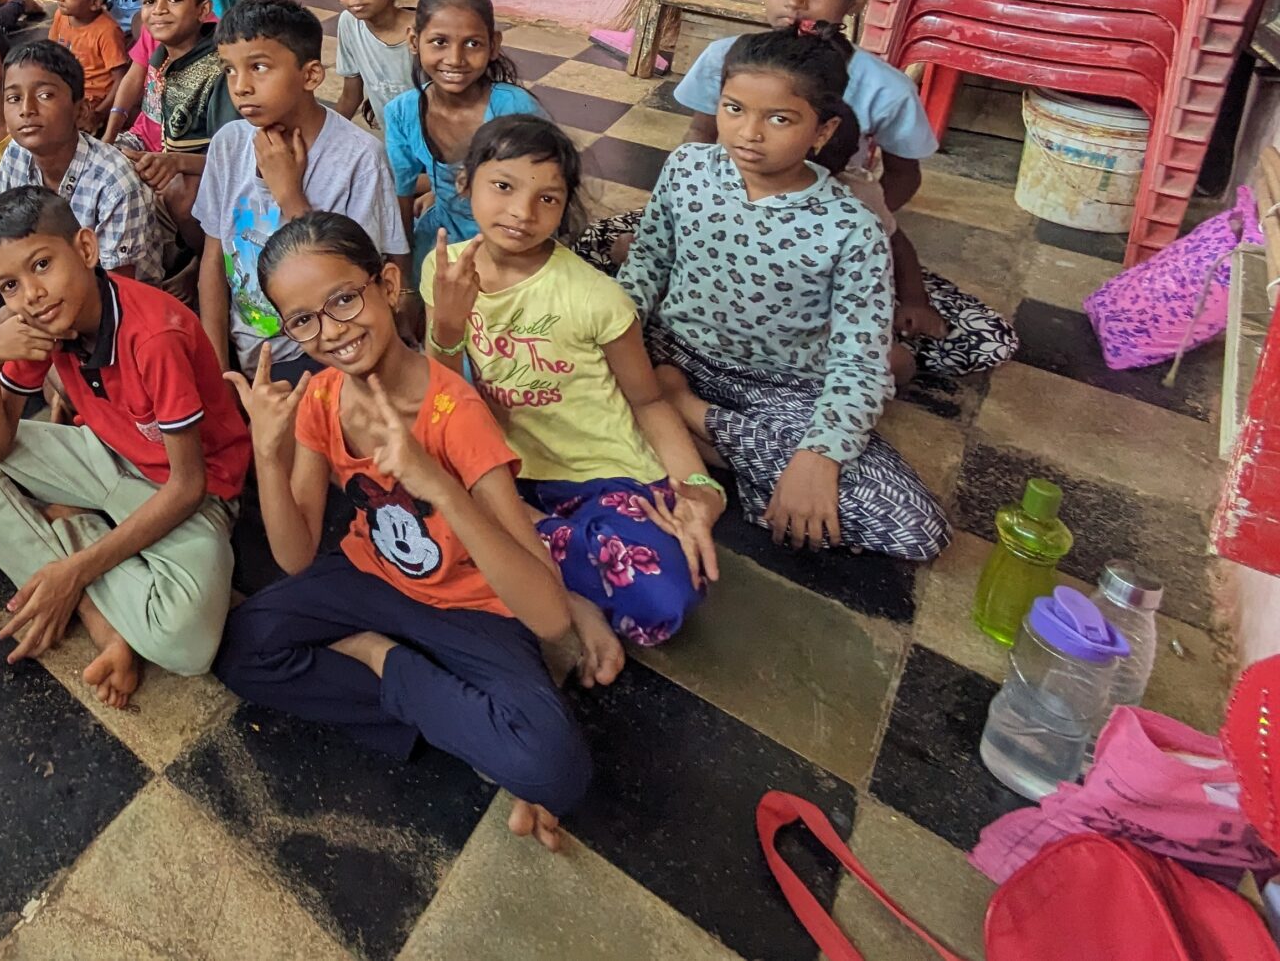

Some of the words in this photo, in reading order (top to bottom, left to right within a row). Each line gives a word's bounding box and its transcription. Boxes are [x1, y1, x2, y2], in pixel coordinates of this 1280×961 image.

[467, 311, 515, 358] Be
[507, 329, 574, 373] The
[514, 313, 561, 336] will
